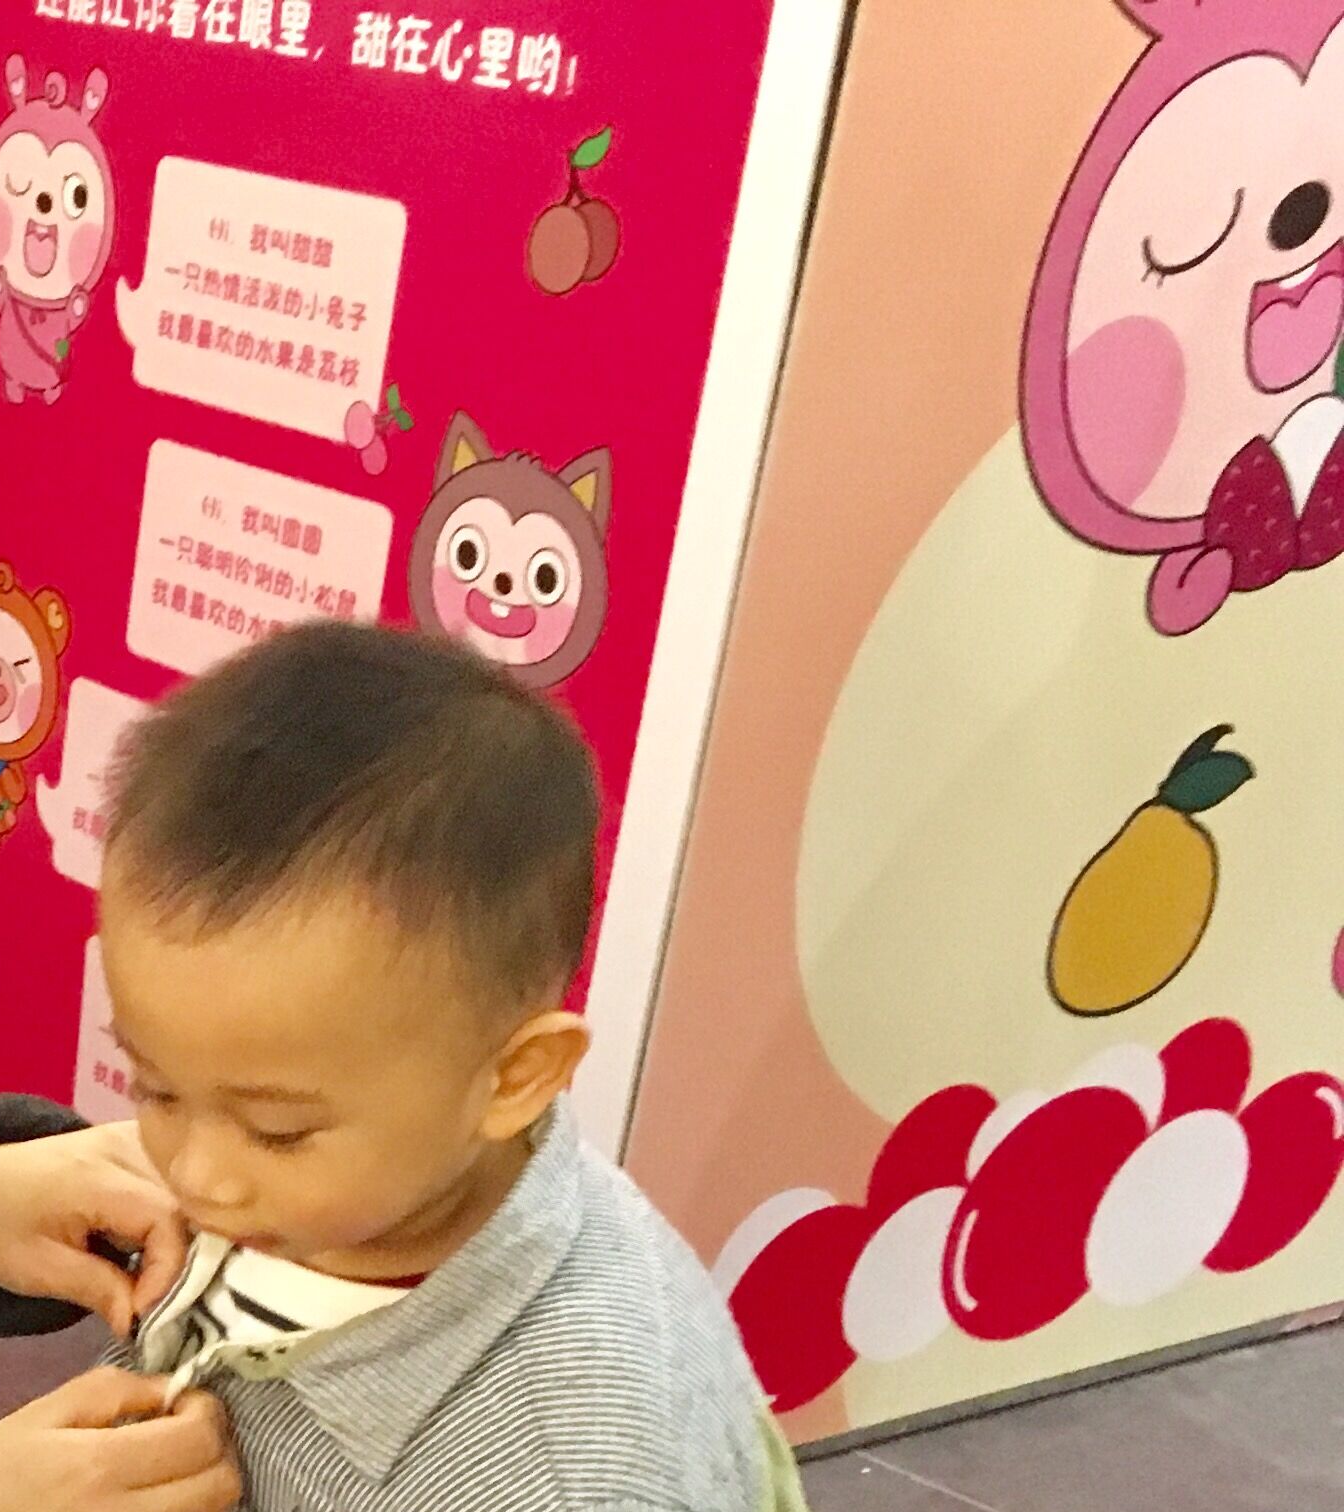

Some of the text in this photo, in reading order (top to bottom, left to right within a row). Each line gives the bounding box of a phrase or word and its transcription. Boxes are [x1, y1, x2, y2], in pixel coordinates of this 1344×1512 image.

[158, 310, 361, 388] 我最喜欢的水果是荔枝
